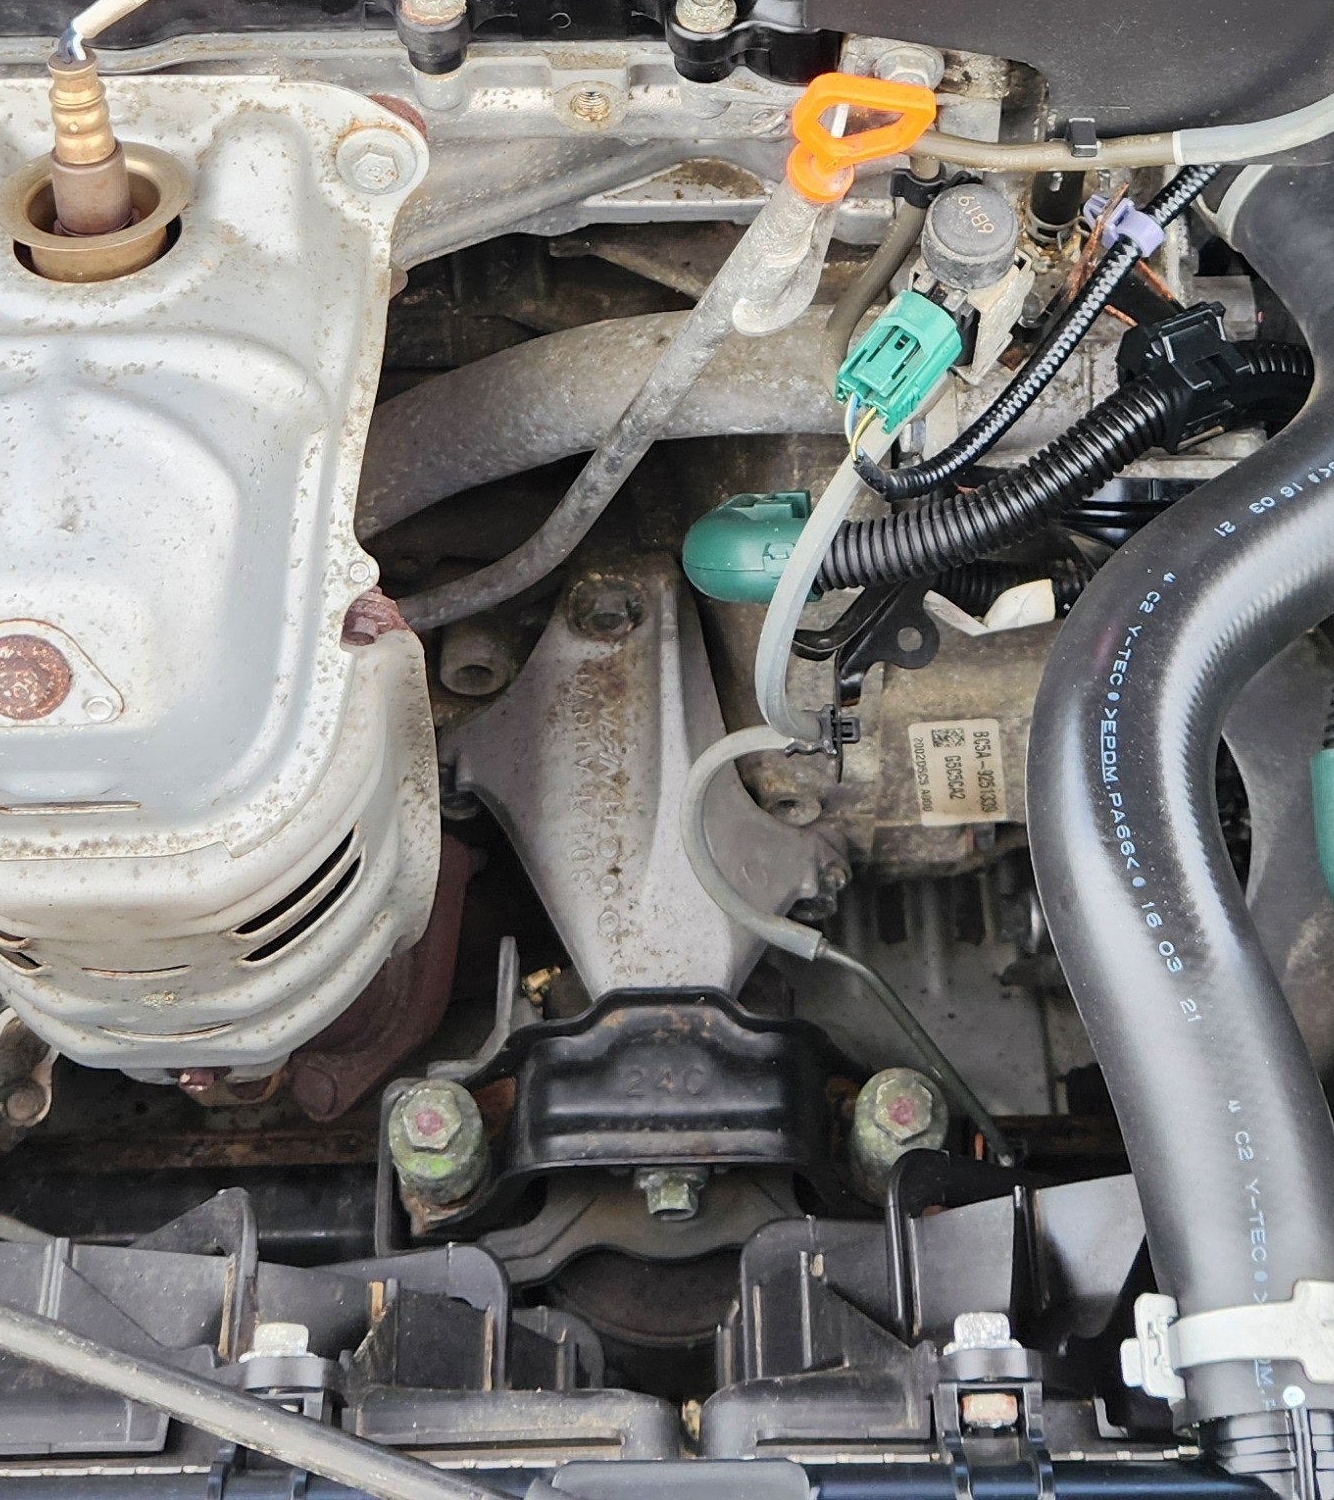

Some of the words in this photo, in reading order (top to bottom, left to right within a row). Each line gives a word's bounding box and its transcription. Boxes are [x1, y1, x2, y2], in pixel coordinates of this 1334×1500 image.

[1140, 900, 1164, 929] 16
[1158, 940, 1184, 974] 03
[1178, 997, 1203, 1023] 21
[1244, 1177, 1268, 1264] Y-TEC
